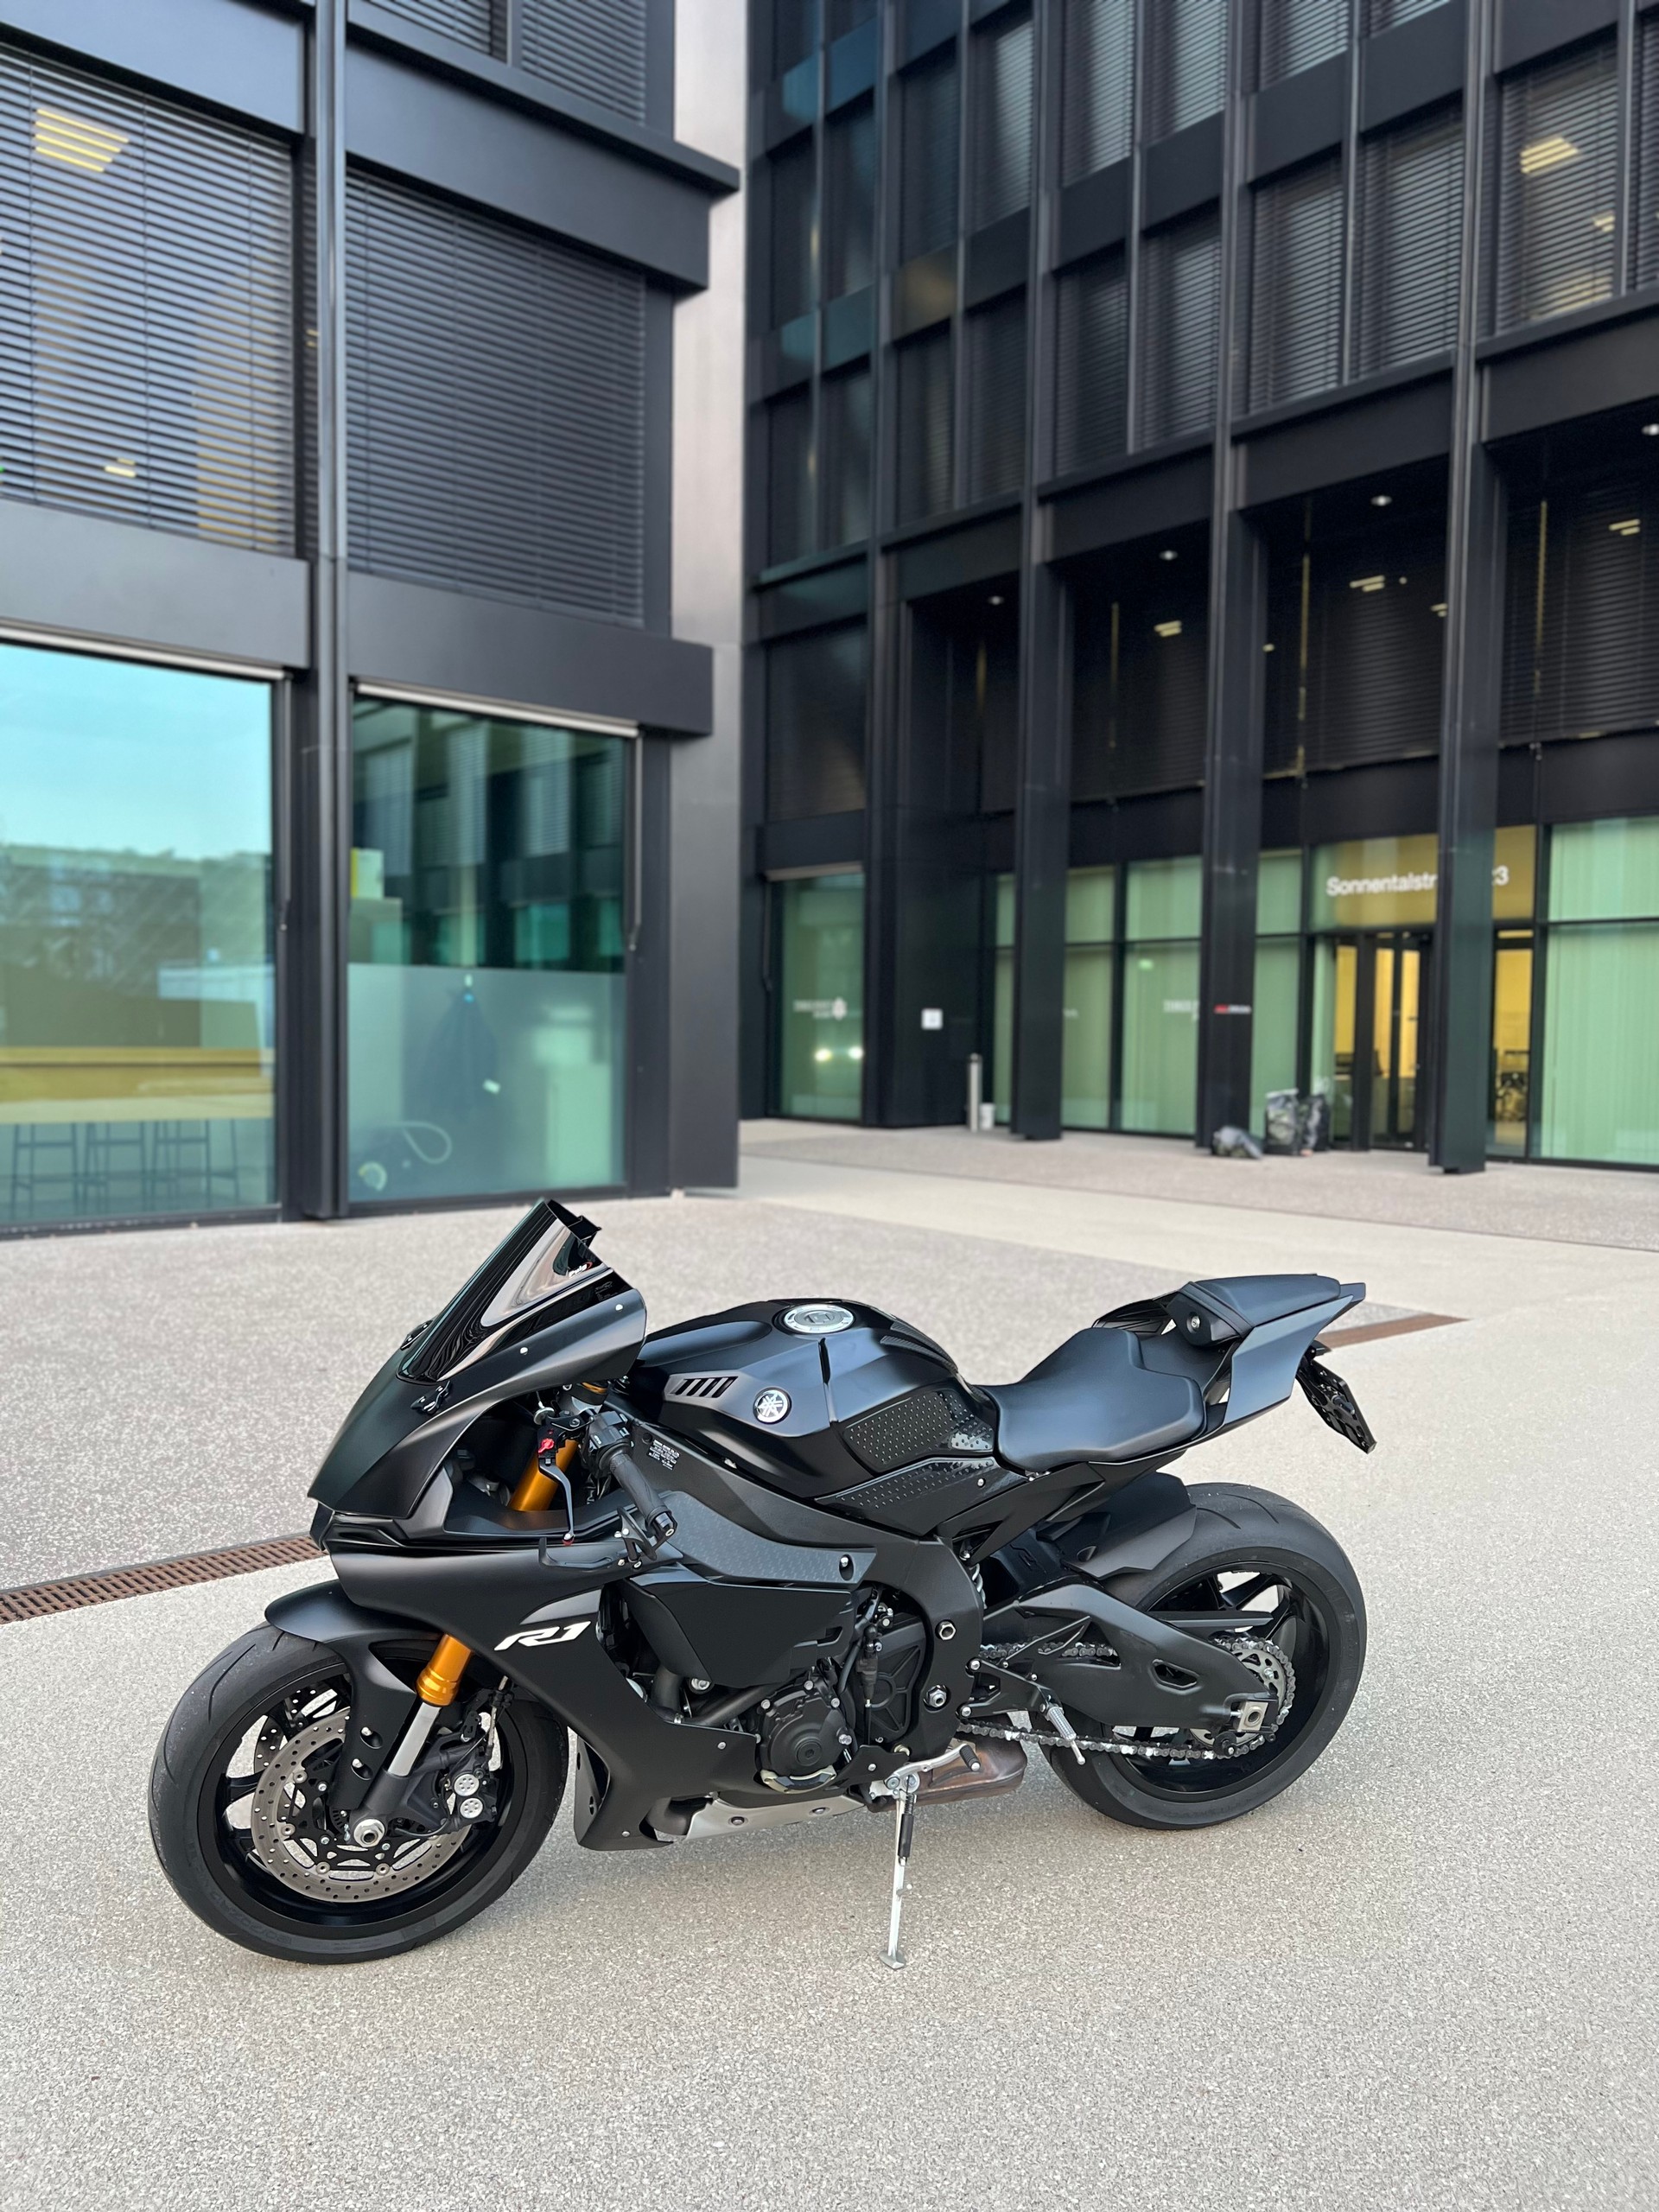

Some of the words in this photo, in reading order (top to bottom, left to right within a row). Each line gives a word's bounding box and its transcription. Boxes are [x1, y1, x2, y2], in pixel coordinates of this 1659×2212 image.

[1326, 872, 1439, 896] Sonnentalstr
[1491, 865, 1510, 887] 3
[493, 1620, 592, 1651] R1
